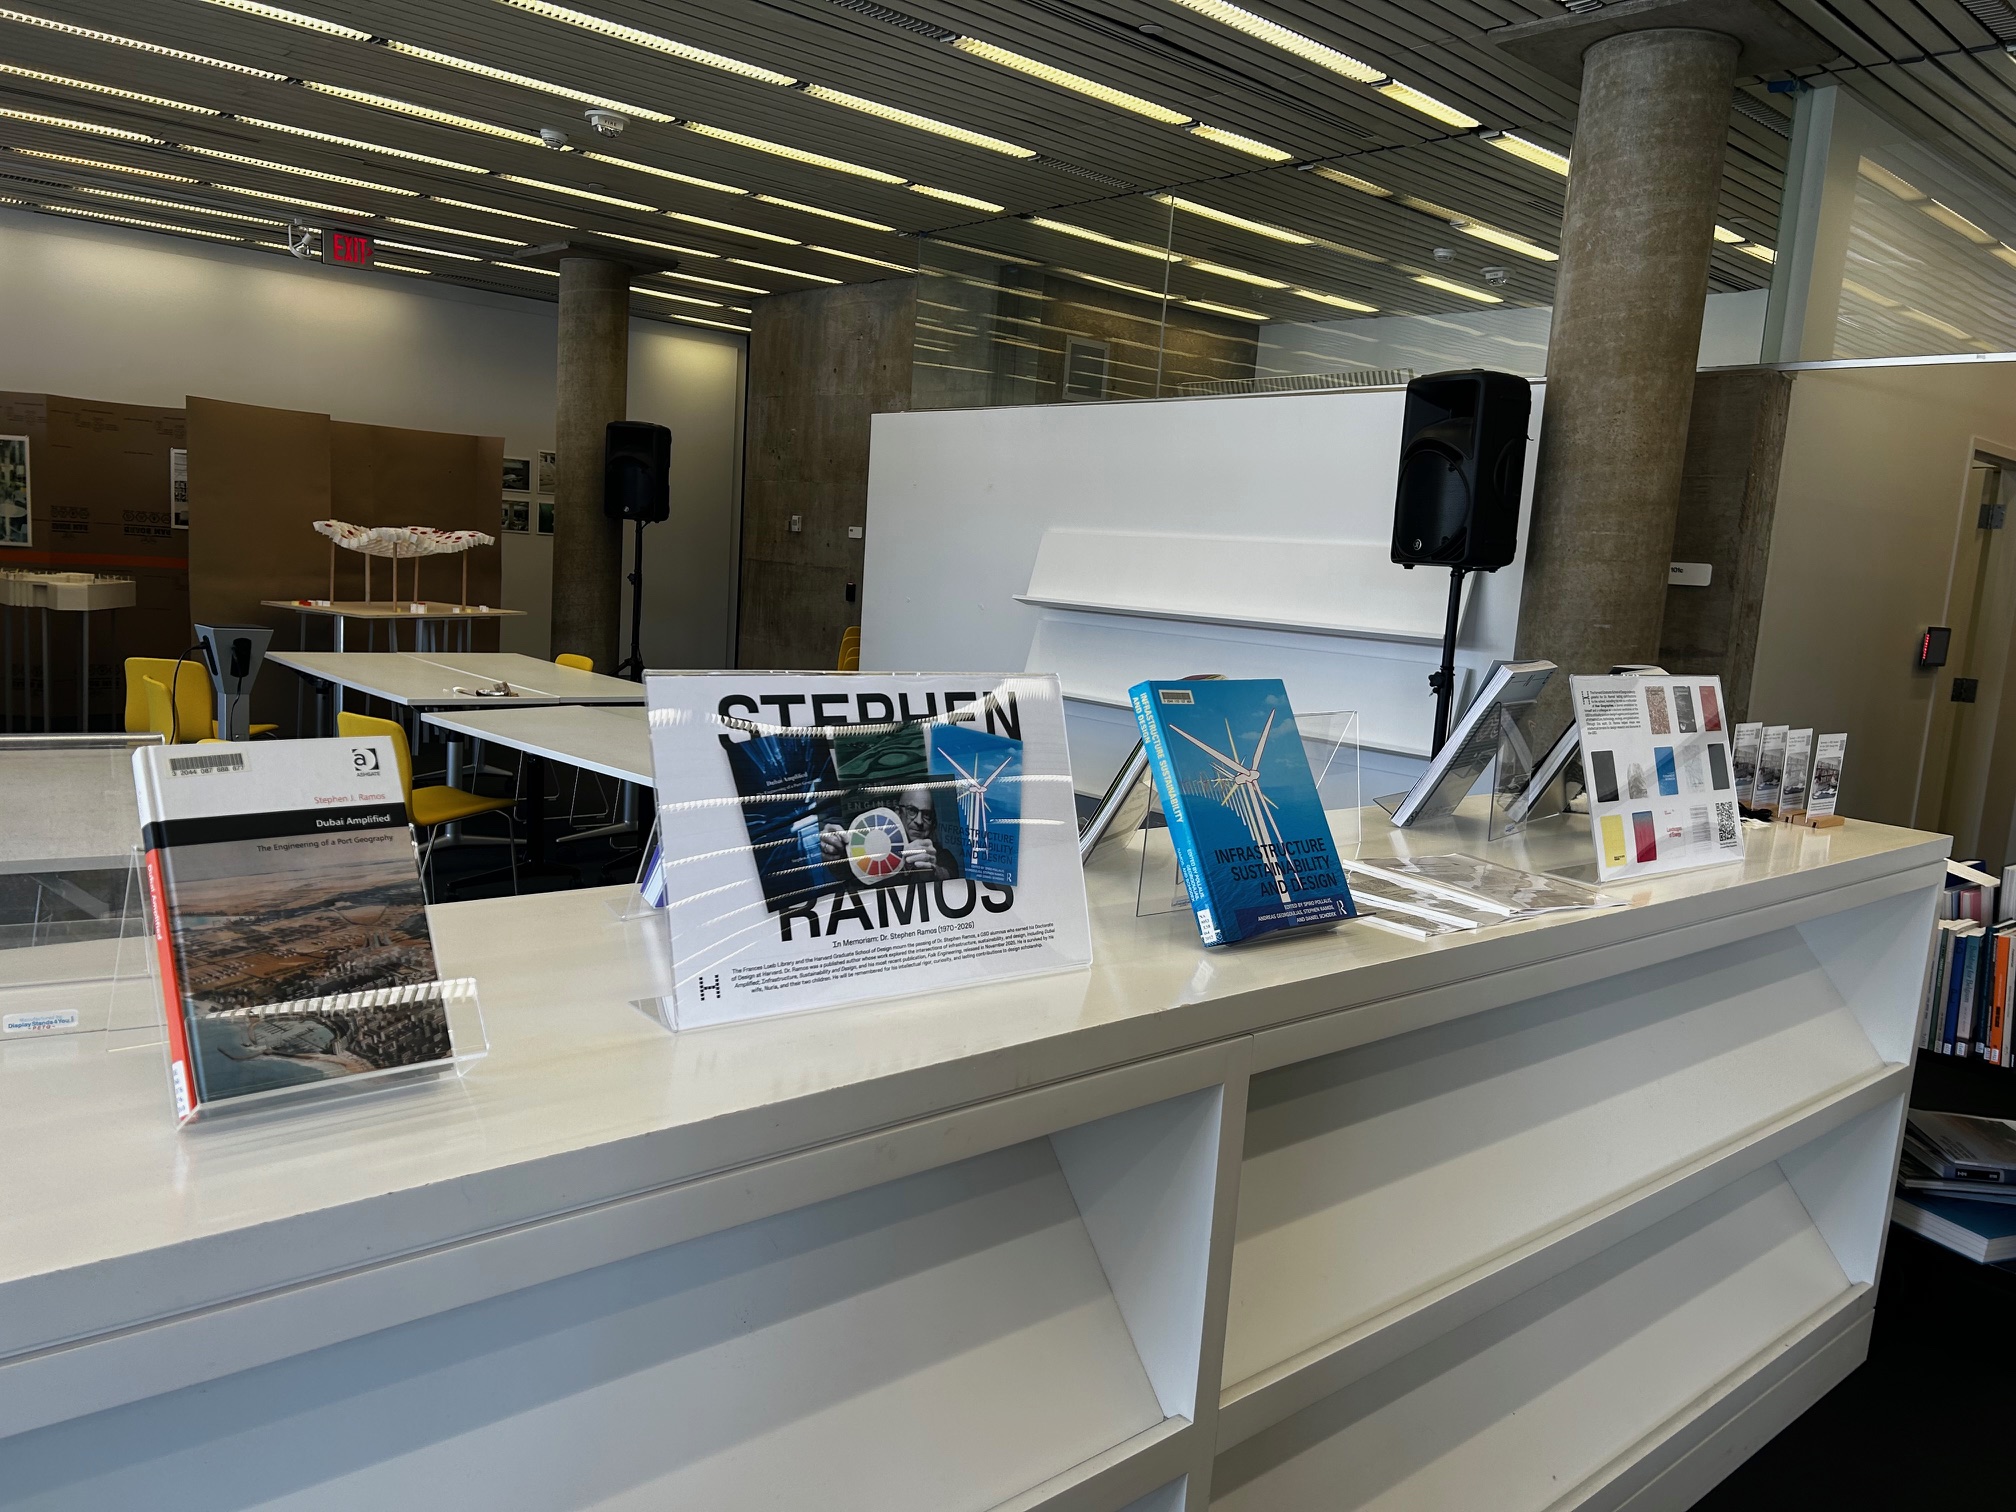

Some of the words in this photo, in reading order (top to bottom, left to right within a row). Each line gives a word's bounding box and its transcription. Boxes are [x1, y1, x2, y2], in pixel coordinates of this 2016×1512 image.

[333, 233, 367, 265] EXIT
[1132, 696, 1142, 714] AND
[1138, 714, 1150, 744] DESIGN
[1140, 692, 1165, 759] INFRASTRUCTURE
[1160, 760, 1184, 822] SUSTAINABILITY
[314, 794, 348, 804] Stephen
[316, 818, 344, 827] Dubai
[346, 814, 390, 825] Amplified
[274, 840, 319, 851] Engineering
[354, 834, 393, 844] Geography
[940, 824, 1014, 844] INFRASTRUCTURE
[945, 836, 1013, 854] SUSTAINABILITY
[960, 848, 978, 859] AND
[982, 852, 1013, 865] DESIGN
[1187, 849, 1196, 866] EDITED
[1214, 838, 1326, 864] INFRASTRUCTURE
[148, 864, 156, 892] Dubai
[1232, 855, 1330, 881] SUSTAINABILITY
[1261, 880, 1288, 896] AND
[1291, 873, 1338, 892] DESIGN
[151, 895, 162, 941] Amplified
[779, 878, 1015, 942] RAMOS
[1258, 913, 1276, 921] ANDREAS
[843, 936, 879, 947] Memoriam:
[890, 930, 915, 941] Stephen
[917, 928, 937, 937] Ramos
[938, 921, 975, 934] (1970-2026)
[738, 973, 754, 981] Design
[823, 959, 844, 968] published
[888, 950, 906, 958] explored
[916, 945, 942, 953] intersections
[948, 940, 976, 949] infrastructure,
[742, 964, 762, 972] Frances
[776, 960, 793, 968] Library
[832, 951, 853, 959] Graduate
[876, 945, 891, 953] Design
[944, 935, 960, 943] Stephen
[854, 968, 882, 976] remembered
[975, 949, 1002, 957] contributions
[1966, 945, 1977, 969] Building
[761, 973, 798, 984] Infrastructure,
[799, 968, 830, 978] Sustainability
[1966, 970, 1974, 978] for
[699, 975, 720, 1000] H
